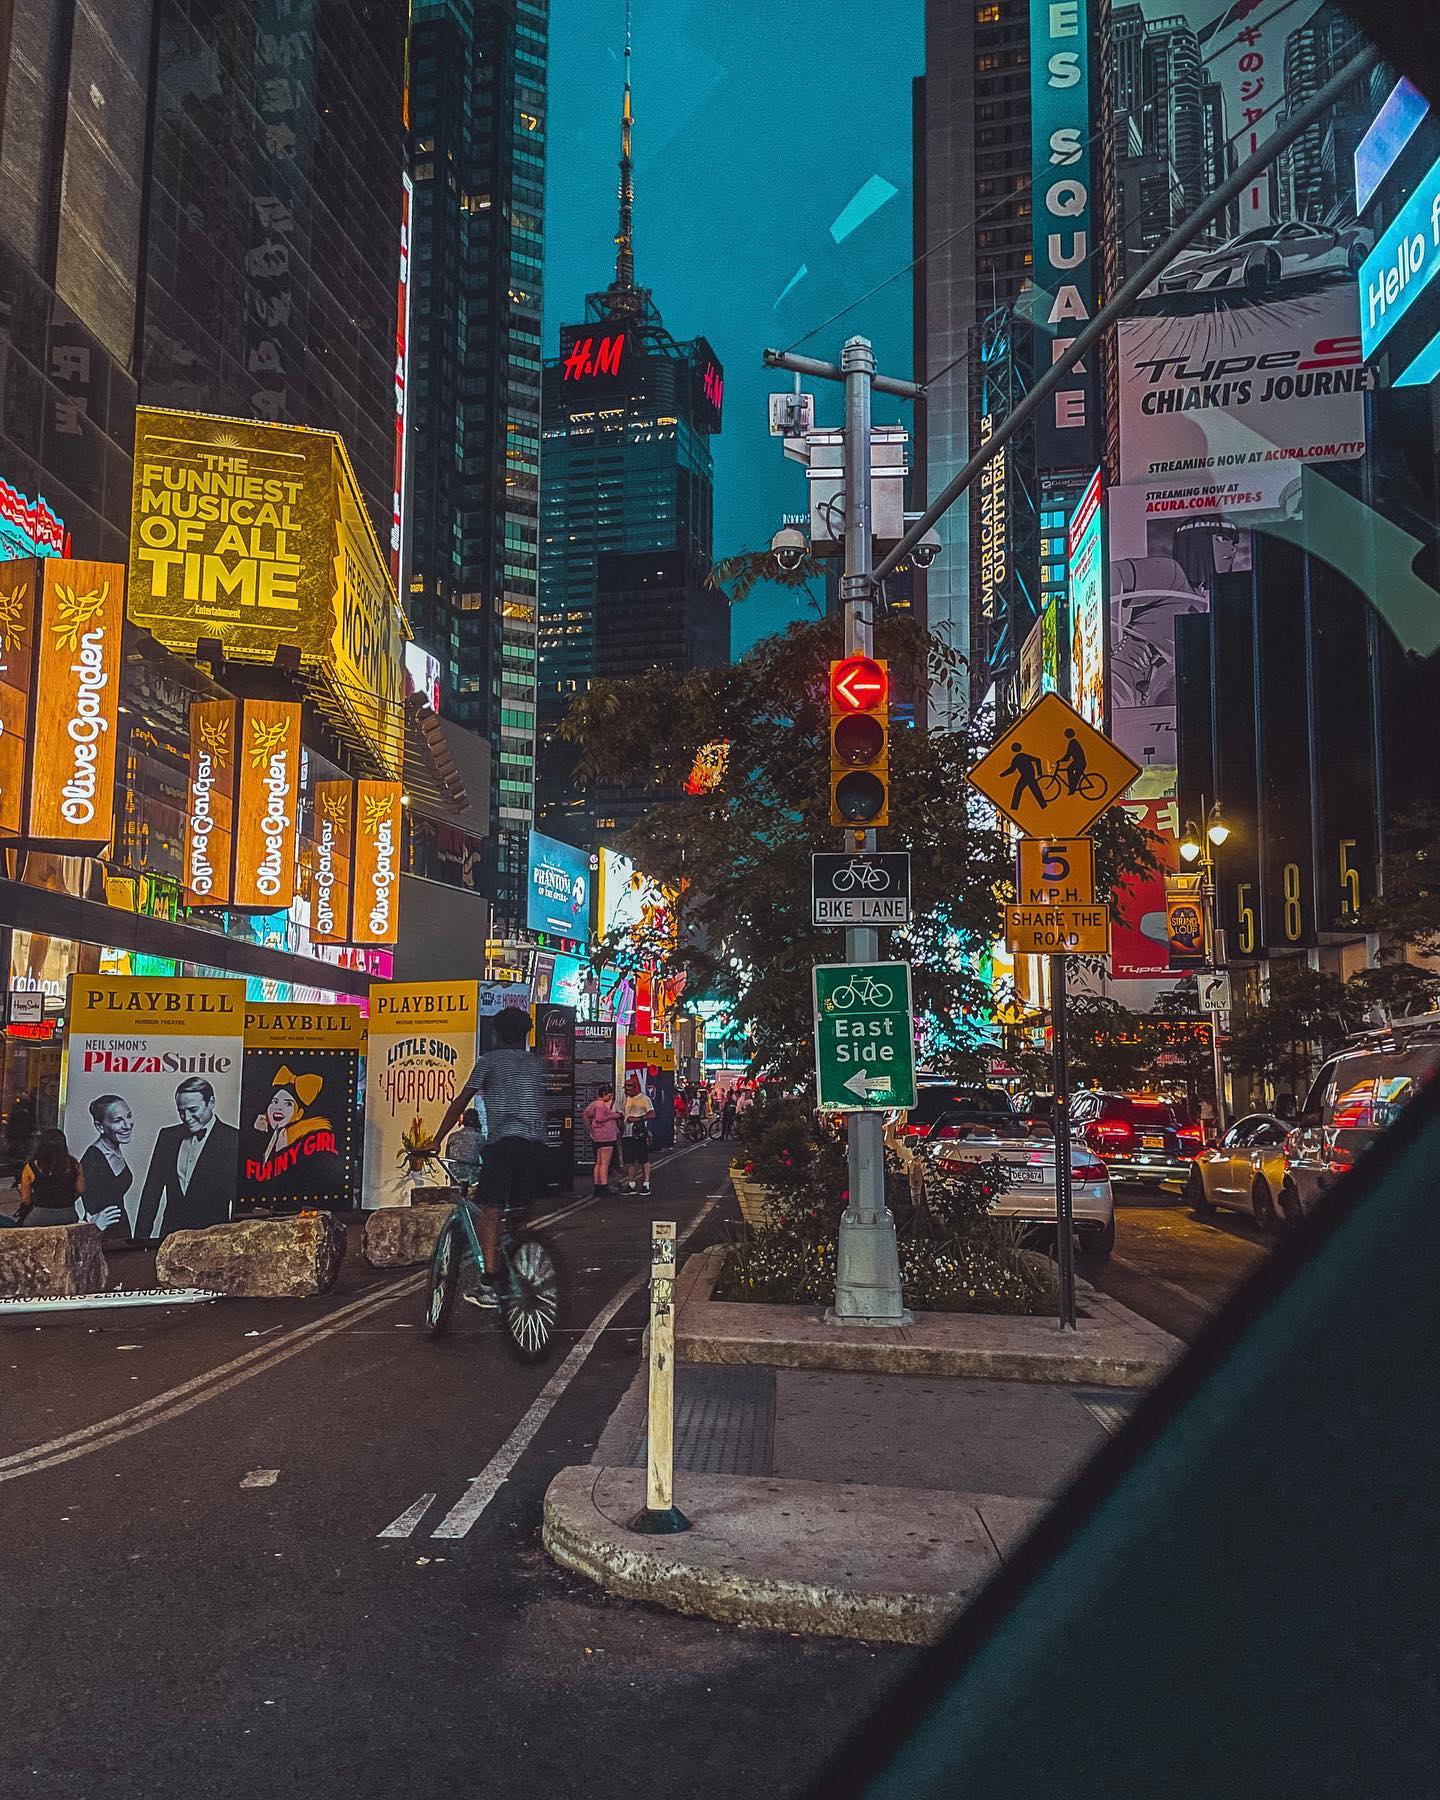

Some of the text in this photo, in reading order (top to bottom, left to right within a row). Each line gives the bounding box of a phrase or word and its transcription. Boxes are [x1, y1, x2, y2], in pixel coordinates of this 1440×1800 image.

[1368, 232, 1425, 330] Hello
[563, 333, 625, 381] H&M
[1133, 336, 1364, 384] Type S
[1141, 365, 1381, 416] CHIAKI'S JOURNEY
[1149, 456, 1215, 474] STREAMING
[1217, 453, 1247, 466] NOW
[1248, 452, 1263, 463] AT
[142, 463, 304, 505] FUNNIEST
[1145, 483, 1239, 501] STREAMING NOW AT
[141, 487, 302, 531] MUSICAL
[1145, 491, 1263, 513] ACURA.COM/TYPE-S
[993, 445, 1006, 584] OUTFITTER
[140, 515, 300, 563] OF ALL
[344, 546, 356, 589] THE
[981, 495, 994, 619] AMERICAN
[1041, 846, 1070, 881] 5
[533, 867, 571, 894] PHANTOM
[538, 887, 545, 895] OF
[545, 889, 554, 898] THE
[1030, 888, 1082, 902] M.P.H.
[818, 900, 904, 918] BIKE LANE
[1011, 912, 1102, 927] SHARE THE
[1033, 932, 1079, 946] ROAD
[1175, 924, 1198, 937] LOOP
[1118, 965, 1161, 974] Type
[85, 990, 235, 1013] PLAYBILL
[377, 995, 469, 1014] PLAYBILL
[1205, 1001, 1226, 1009] ONLY
[244, 1014, 351, 1031] PLAYBILL
[585, 1026, 613, 1037] GALLERY
[835, 1017, 894, 1038] East
[85, 1039, 147, 1051] NEIL SIMON'S
[387, 1037, 458, 1067] LITTLE SHOP
[836, 1041, 894, 1063] Side
[83, 1051, 232, 1074] Plaza Suite
[415, 1058, 425, 1066] OF
[385, 1069, 455, 1110] HORRORS
[303, 1132, 339, 1156] GIRL
